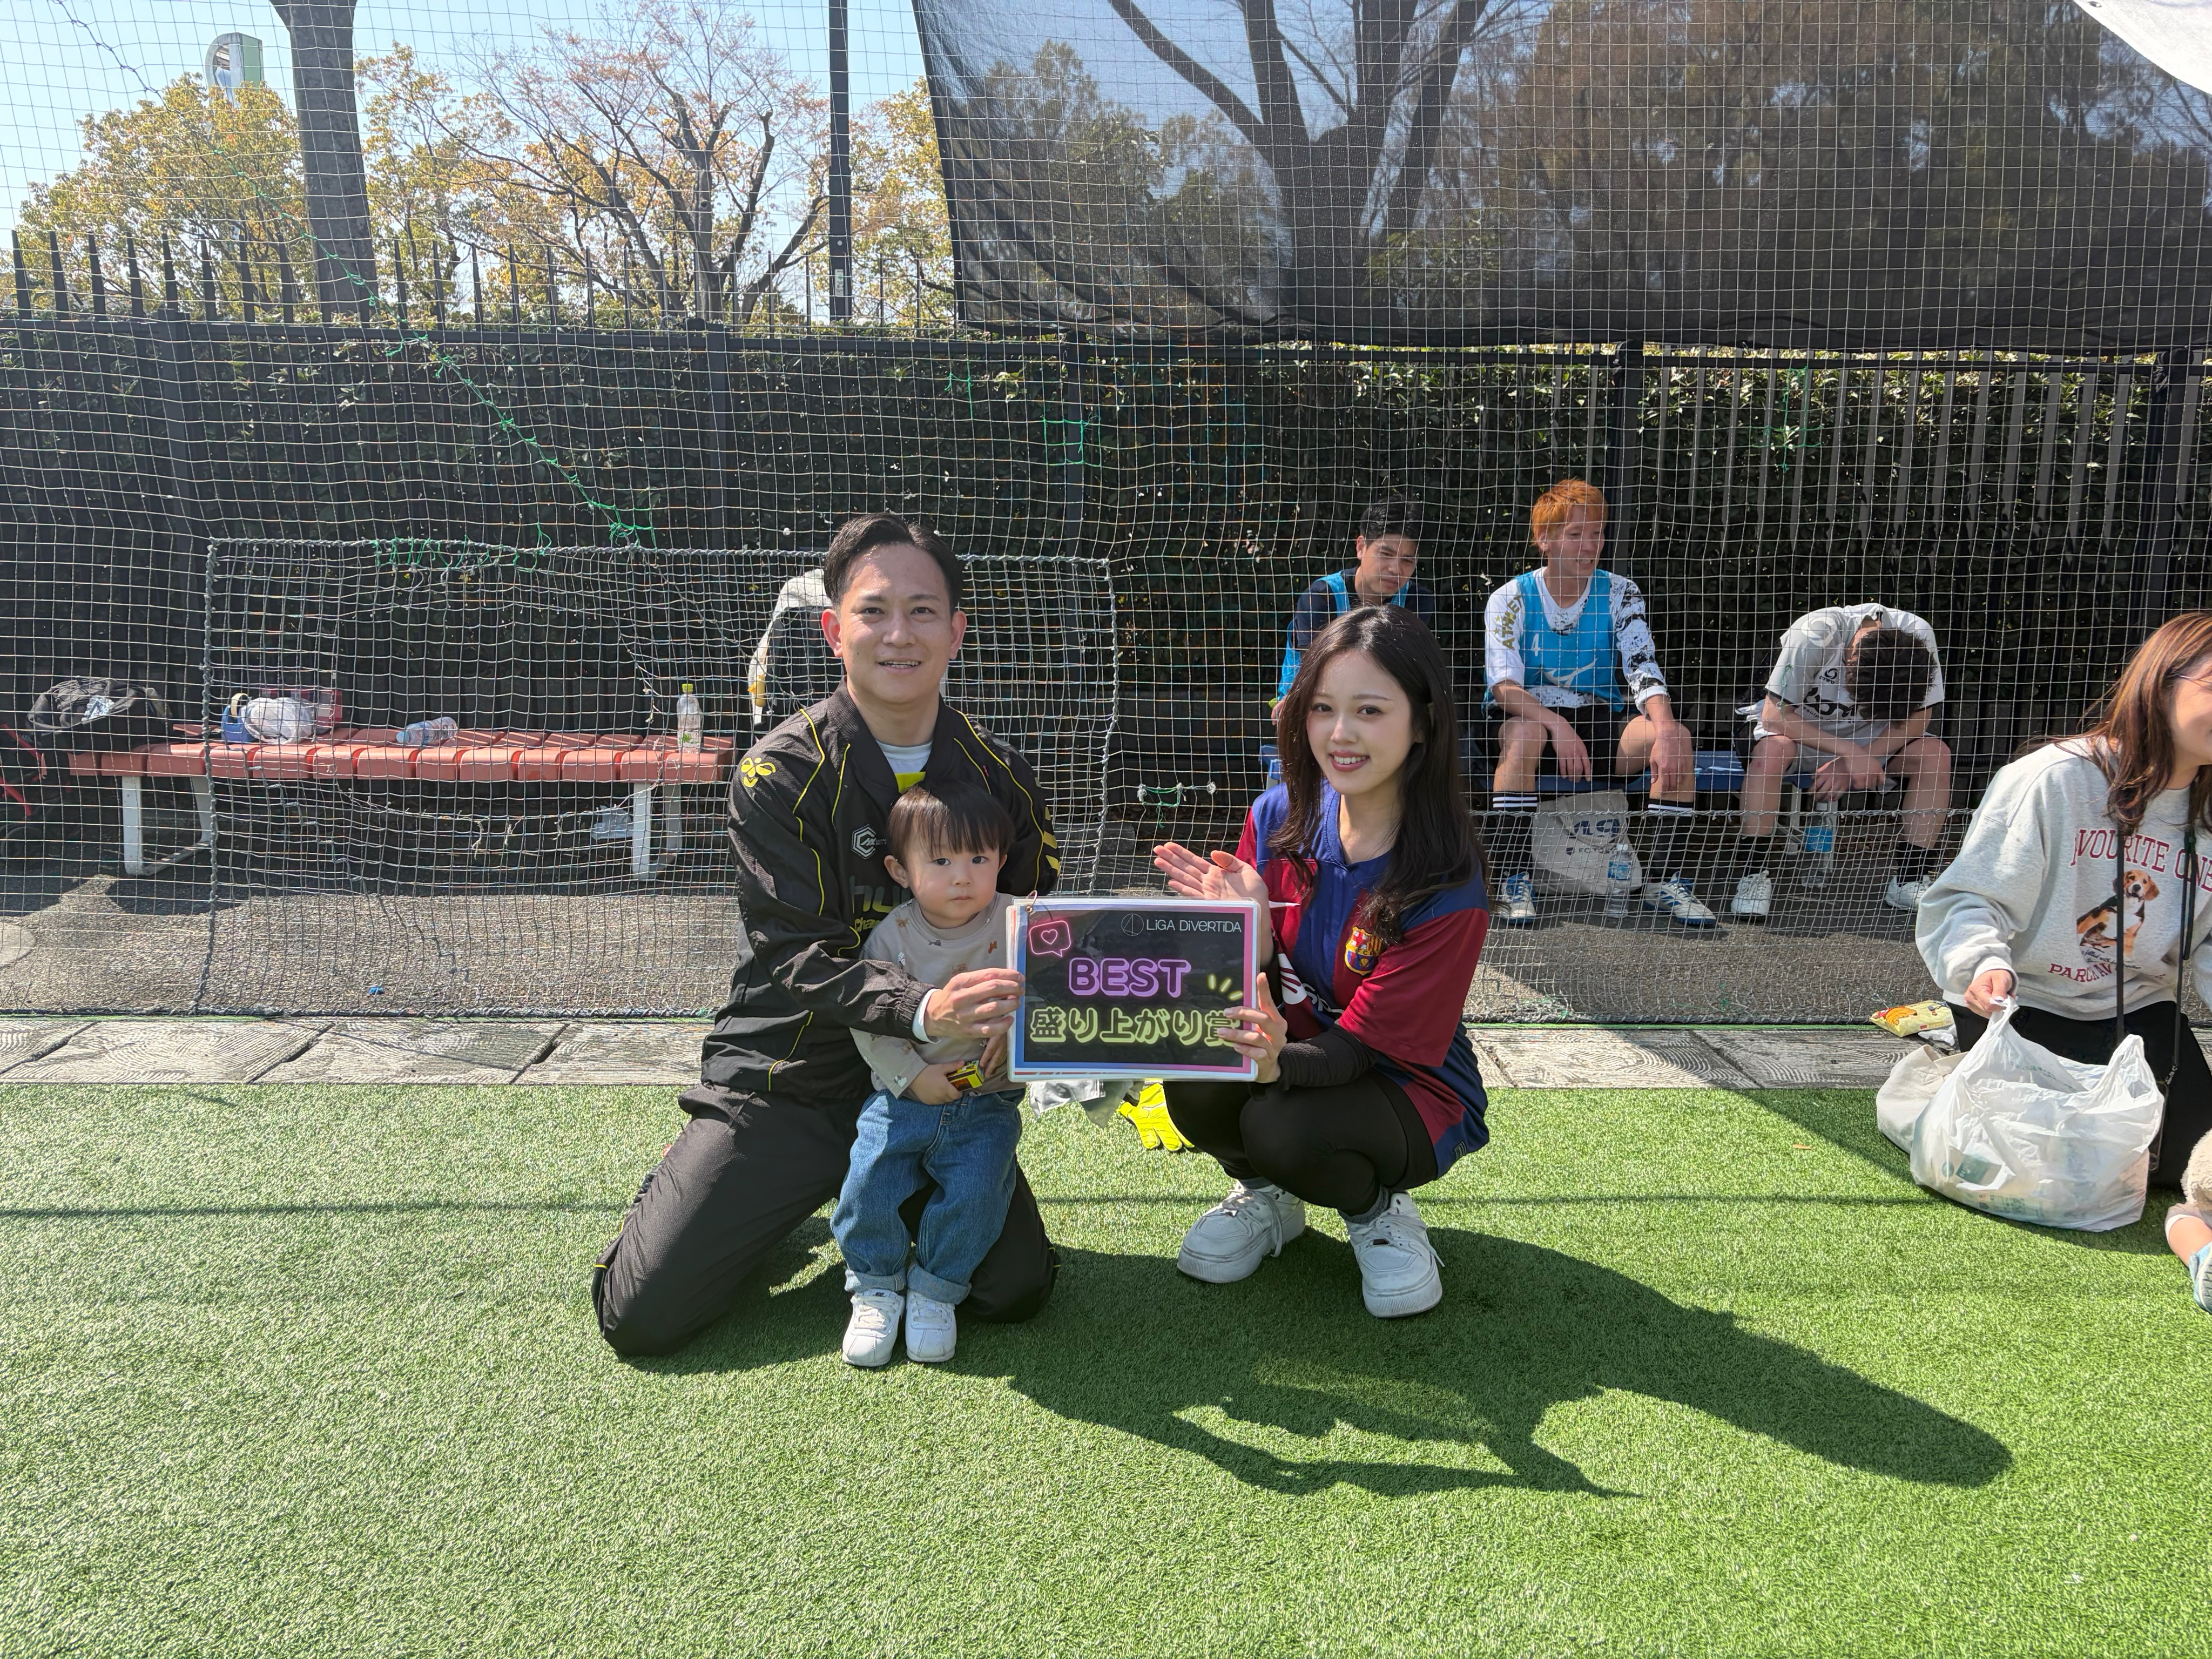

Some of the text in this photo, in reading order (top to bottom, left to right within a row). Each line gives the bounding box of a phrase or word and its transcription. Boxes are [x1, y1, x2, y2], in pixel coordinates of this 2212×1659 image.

[1530, 633, 1541, 657] 4
[849, 875, 911, 914] hu
[1068, 956, 1191, 999] BEST
